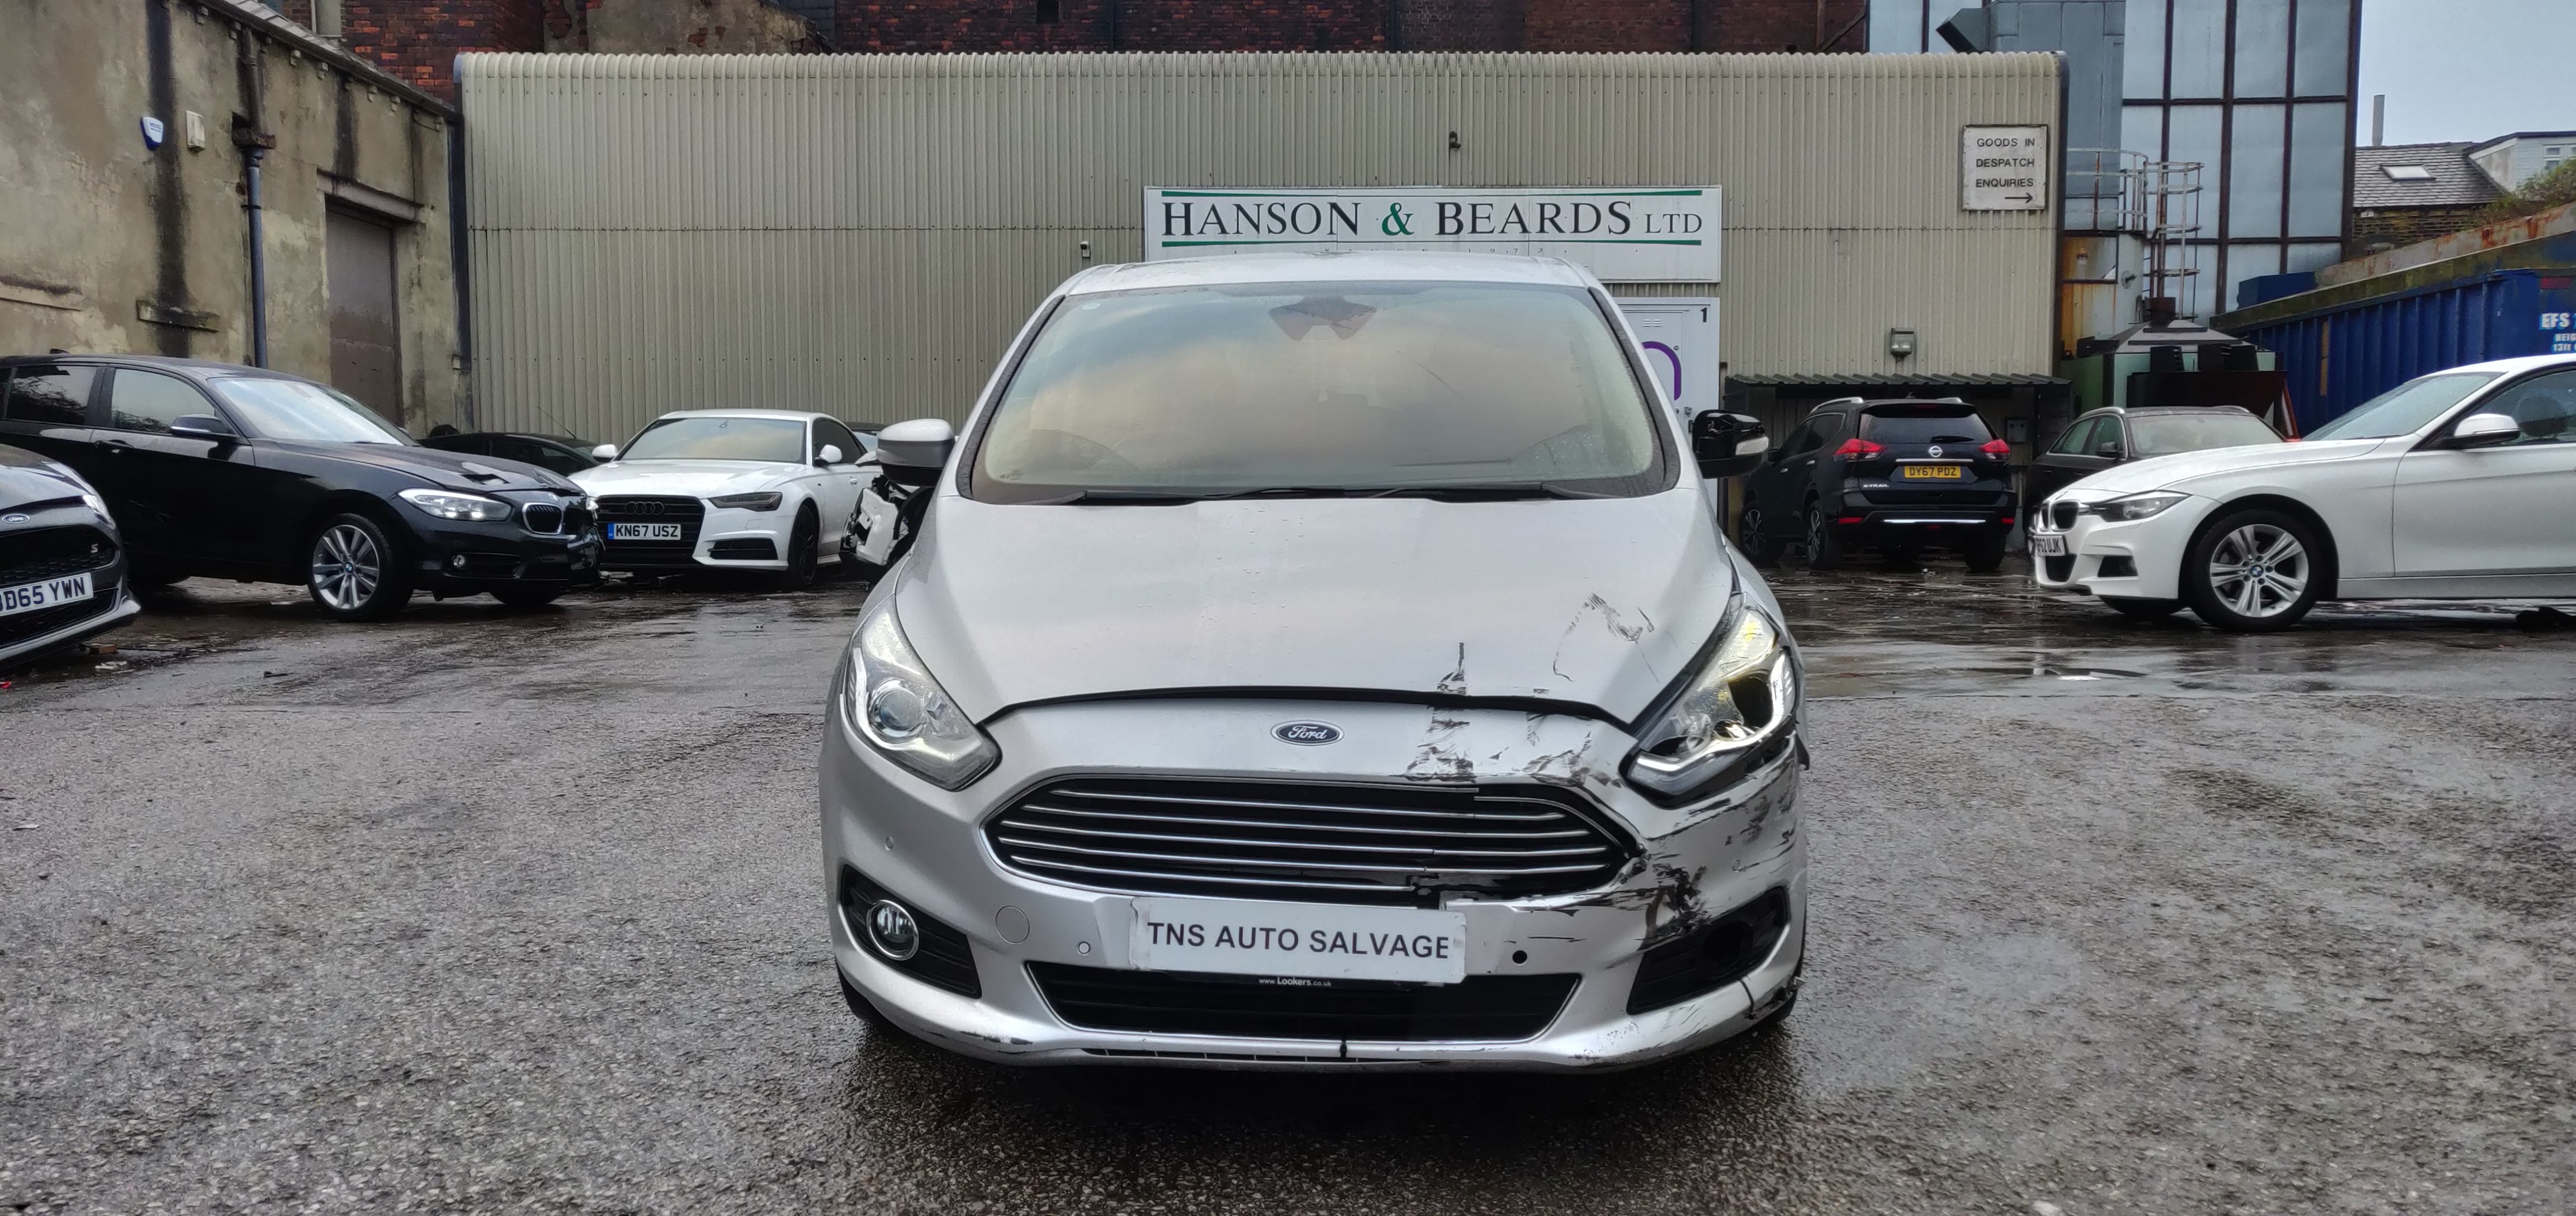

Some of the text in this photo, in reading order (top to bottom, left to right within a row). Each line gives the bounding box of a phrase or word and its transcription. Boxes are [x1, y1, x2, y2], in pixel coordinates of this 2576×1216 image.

[1976, 137, 2035, 147] GOODS IN
[1976, 158, 2035, 167] DESPATCH
[1976, 177, 2034, 187] ENQUIRIES
[1161, 201, 1703, 236] HANSON & BEARDS LTD
[1701, 307, 1707, 322] 1
[2540, 312, 2570, 329] EFS
[1909, 467, 1957, 476] DY67 PDZ
[616, 525, 678, 538] KN67 USZ
[91, 543, 98, 553] S
[0, 577, 86, 612] D65 YWN
[1287, 725, 1328, 739] Ford
[1147, 922, 1449, 959] TNS AUTO SALVAGE
[1258, 976, 1332, 986] www.Lookers.co.uk
